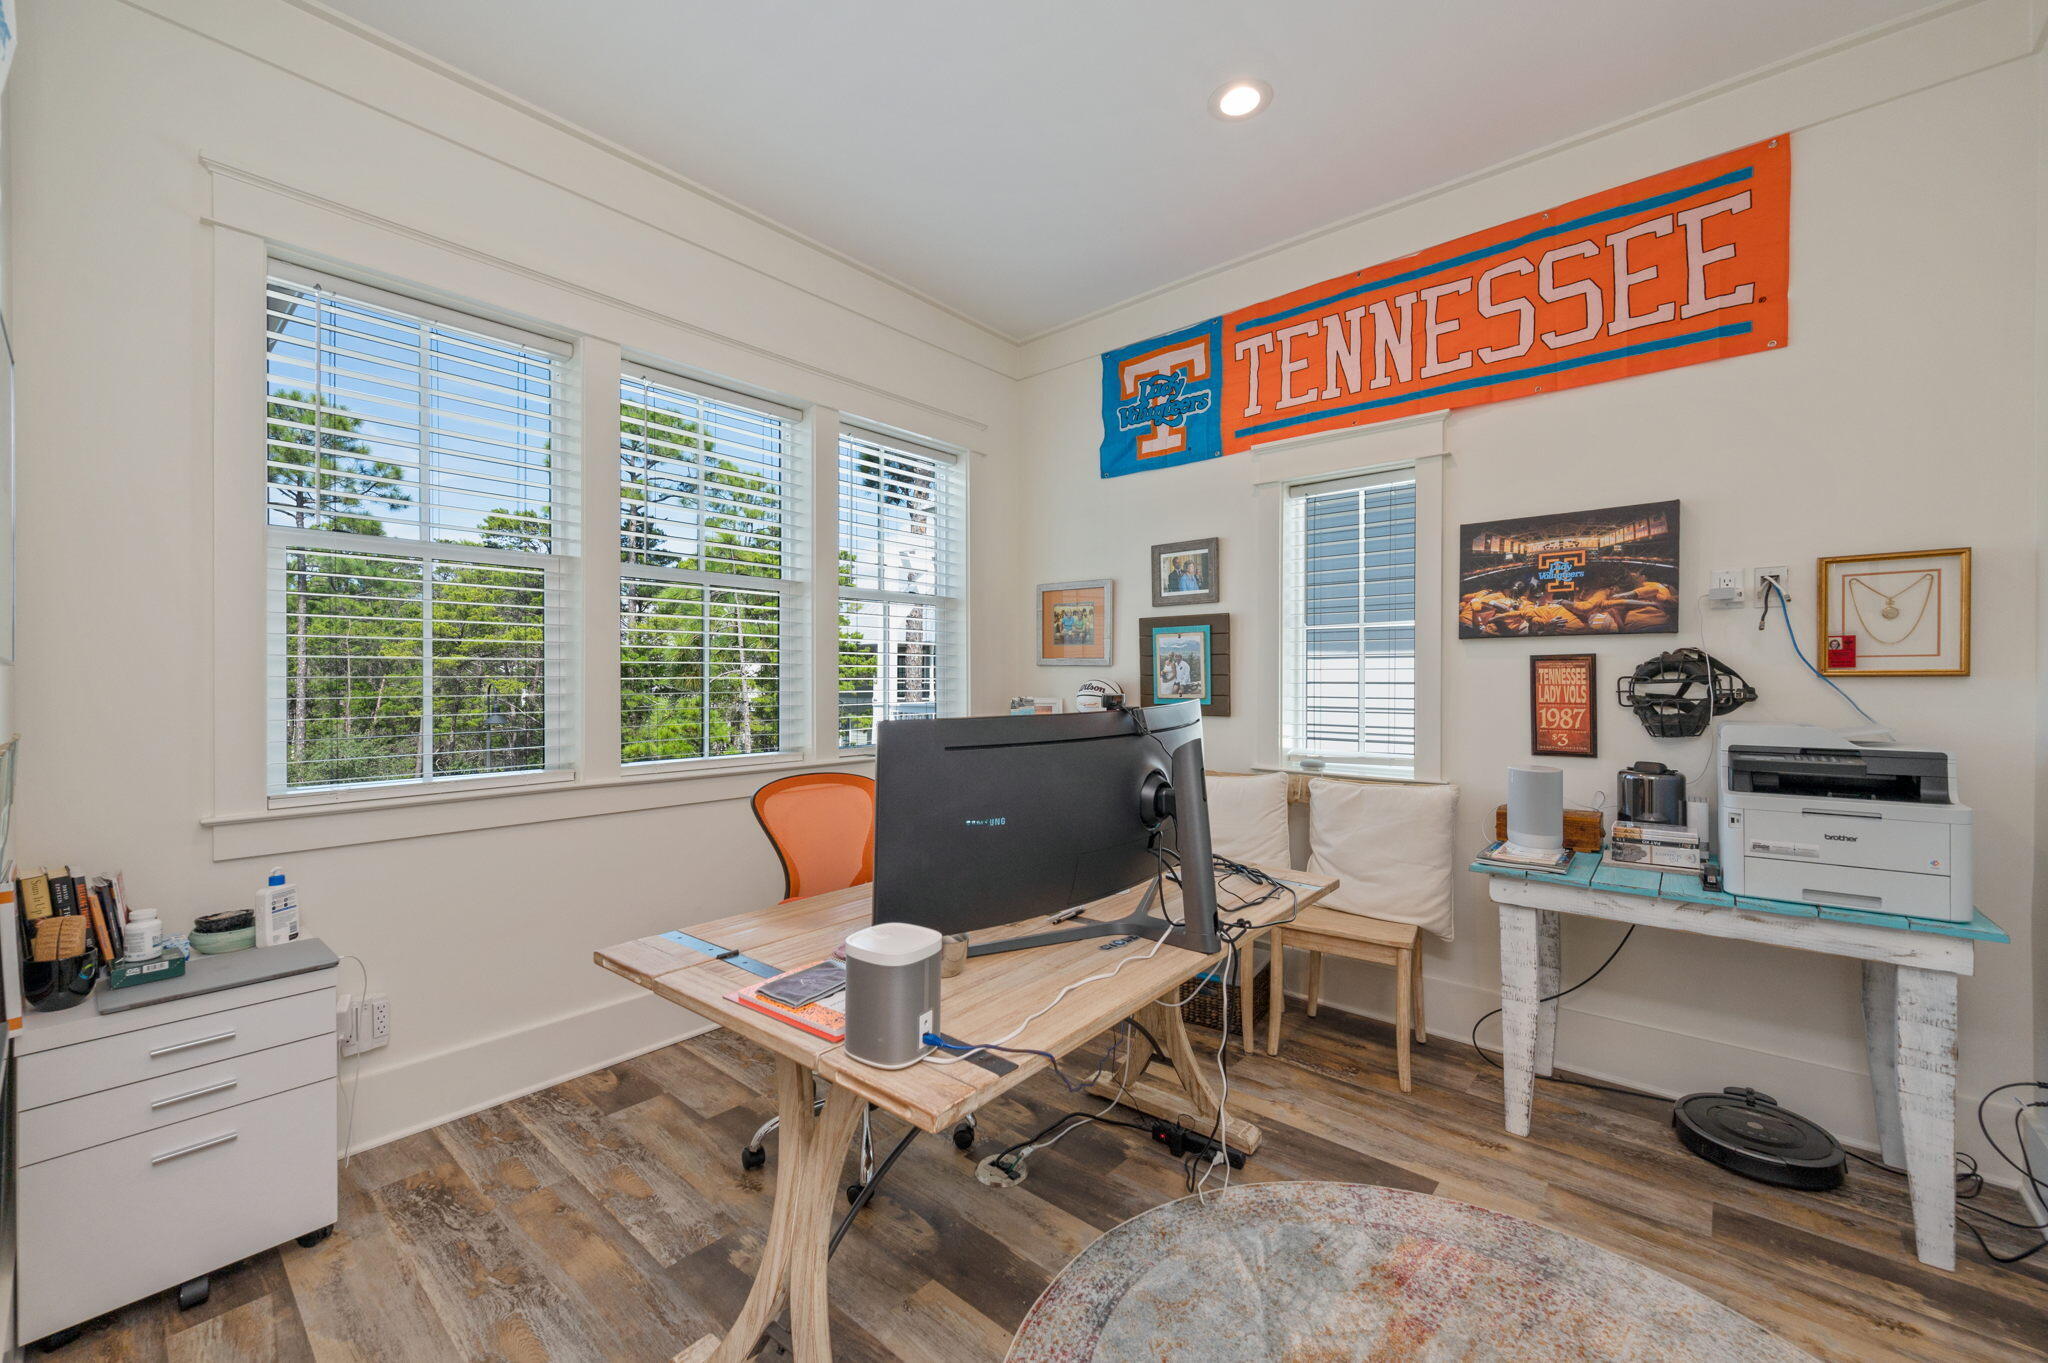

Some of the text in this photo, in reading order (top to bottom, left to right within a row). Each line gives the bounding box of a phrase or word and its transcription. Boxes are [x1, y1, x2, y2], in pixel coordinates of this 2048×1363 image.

[1234, 190, 1755, 417] TENNESSEE
[1138, 370, 1186, 404] Lady
[1538, 667, 1587, 685] TENNESSEE
[1538, 685, 1587, 704] LADY VOLS
[1539, 707, 1587, 729] 1987
[1551, 733, 1569, 747] $3
[1824, 833, 1858, 843] brother
